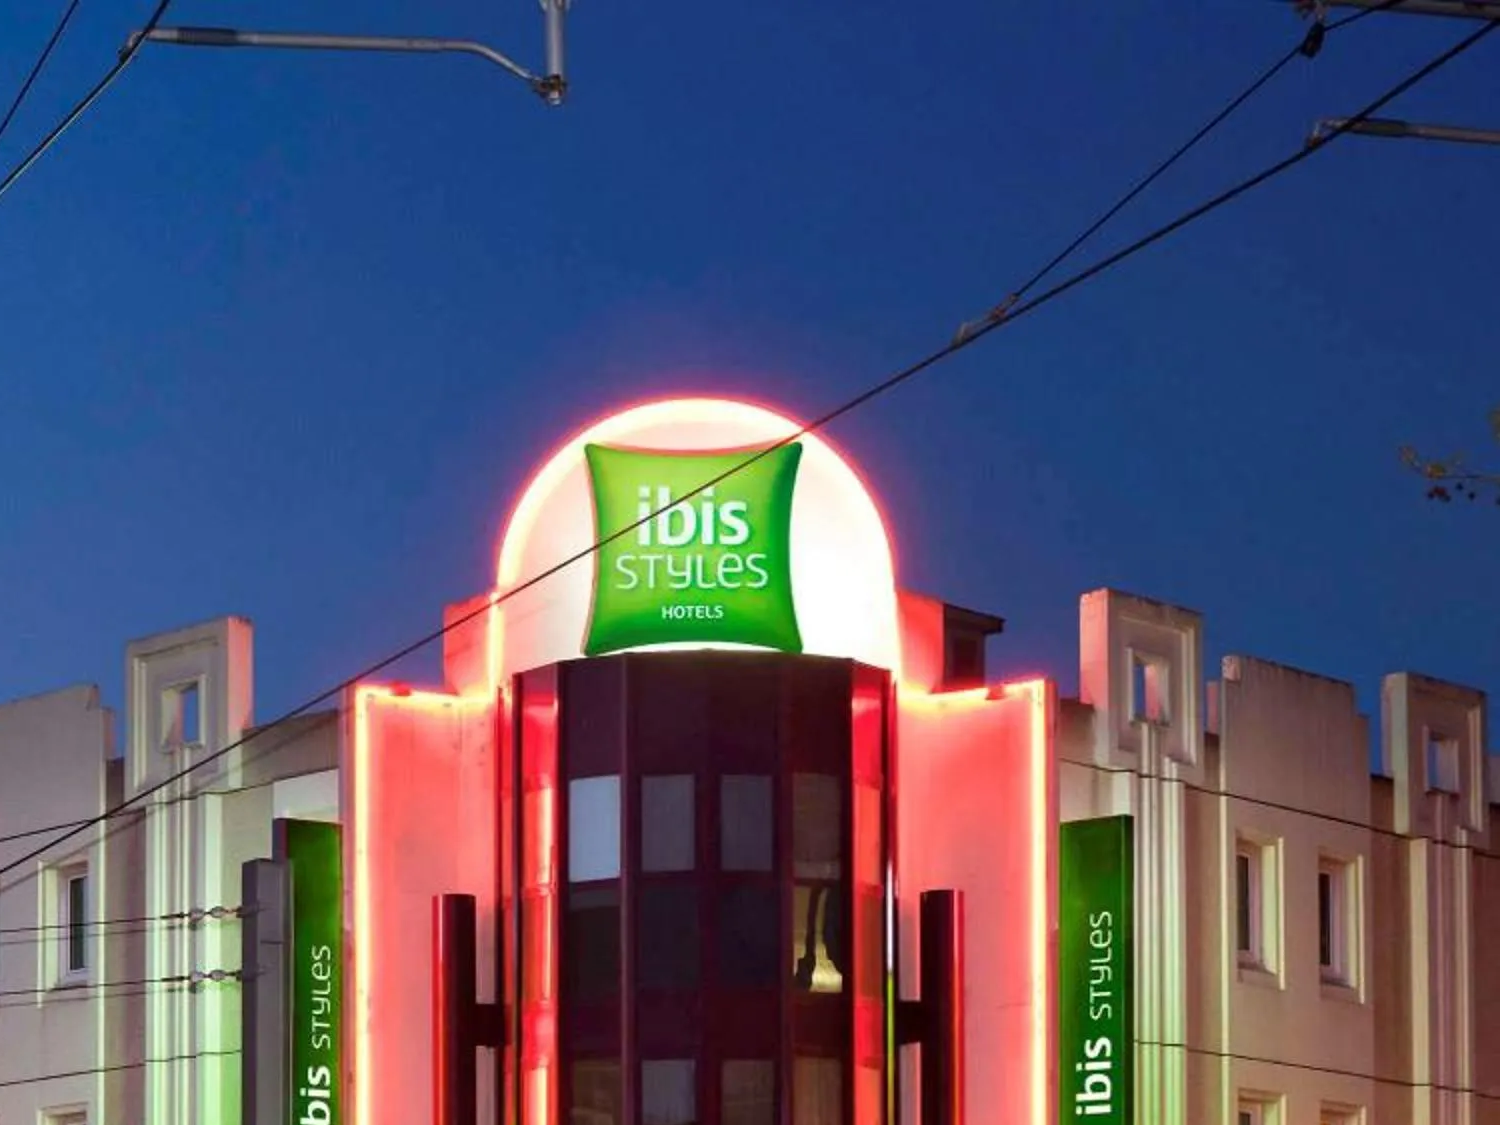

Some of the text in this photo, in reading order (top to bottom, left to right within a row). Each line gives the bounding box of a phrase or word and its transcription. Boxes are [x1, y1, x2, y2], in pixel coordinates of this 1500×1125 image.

[636, 485, 750, 547] ibis
[661, 604, 724, 619] HOTELS
[1075, 1036, 1112, 1116] ibis
